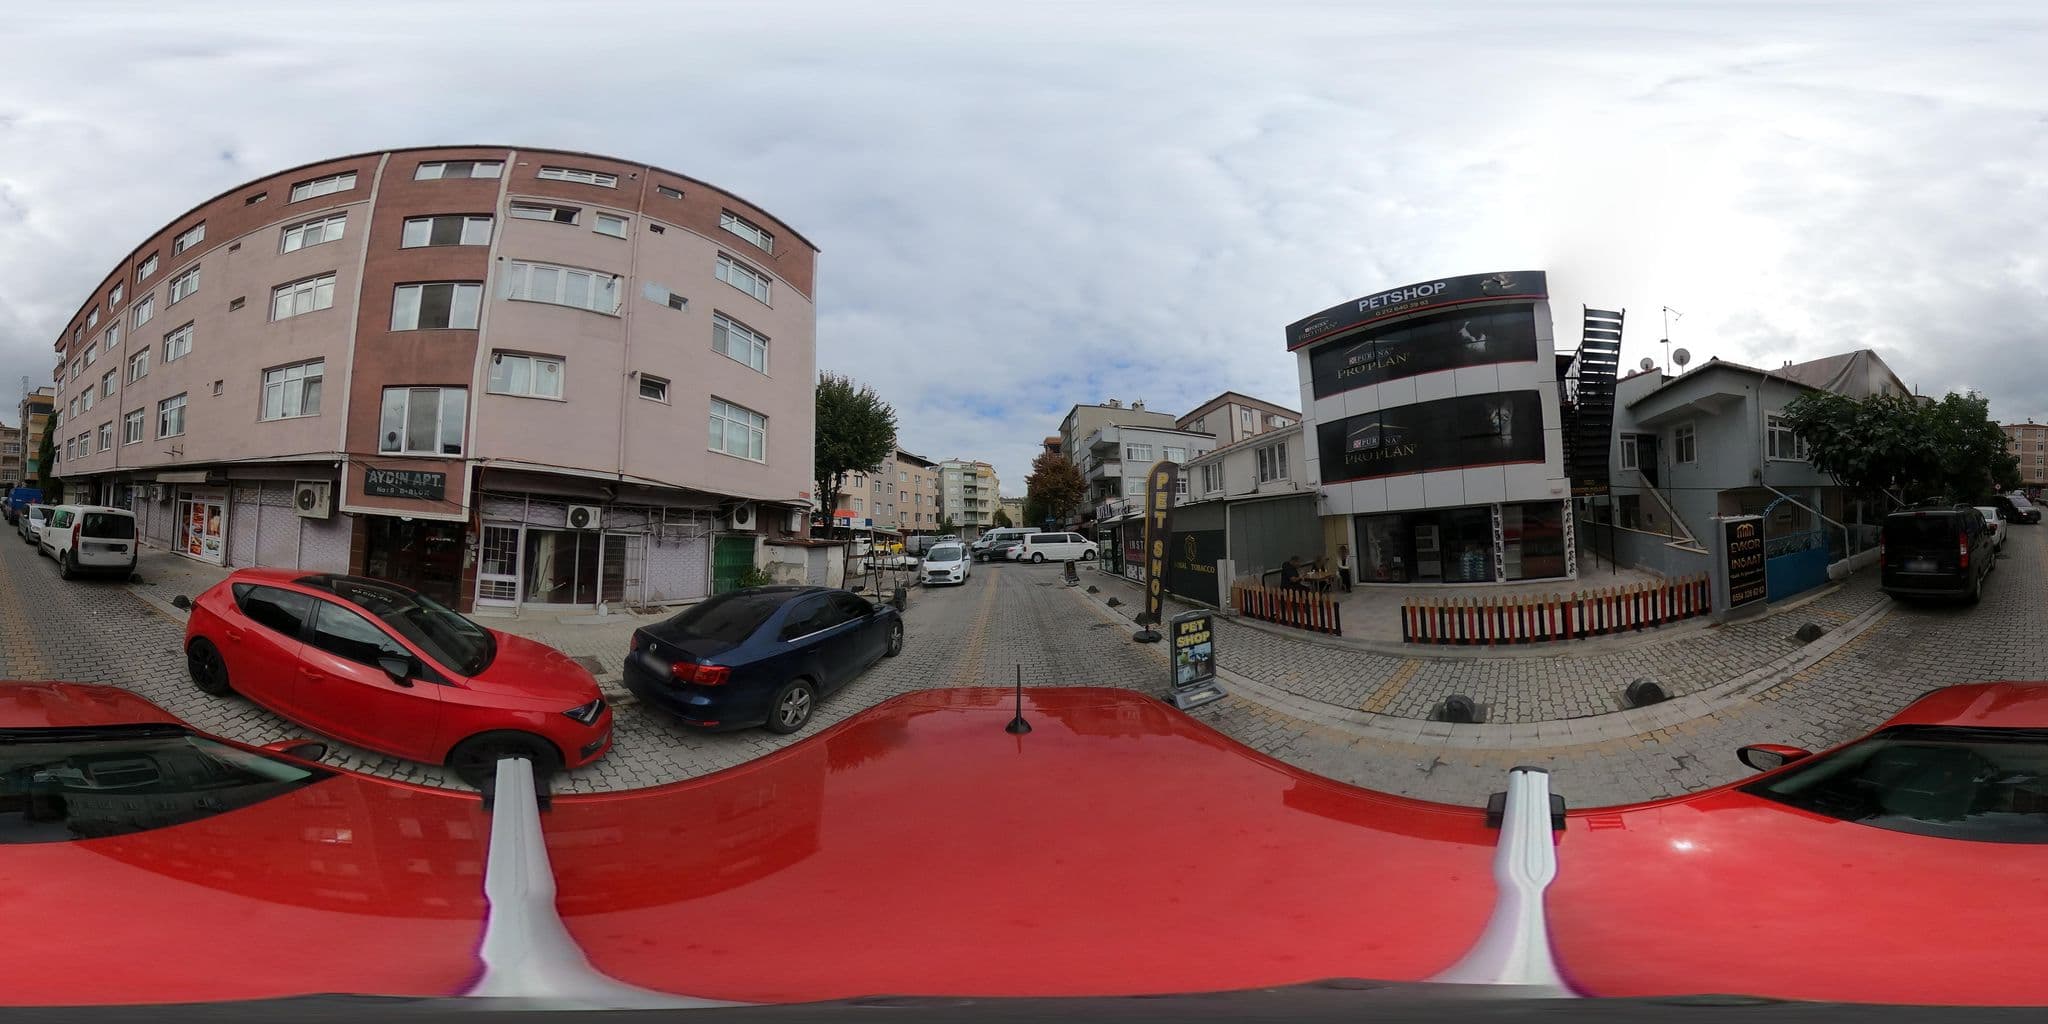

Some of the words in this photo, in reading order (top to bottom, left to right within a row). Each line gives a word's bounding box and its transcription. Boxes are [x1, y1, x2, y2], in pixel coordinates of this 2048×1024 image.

[1358, 282, 1447, 312] PETSHOP
[1336, 363, 1366, 379] PRO
[1367, 352, 1408, 371] PLAN
[1345, 453, 1373, 465] PRO
[1375, 443, 1415, 460] PLAN
[412, 473, 442, 487] APT.
[1154, 472, 1169, 529] PET
[1151, 540, 1164, 614] SHOP
[1190, 563, 1216, 574] TOBACCO
[1180, 619, 1206, 635] PET
[1176, 630, 1211, 648] SHOP
